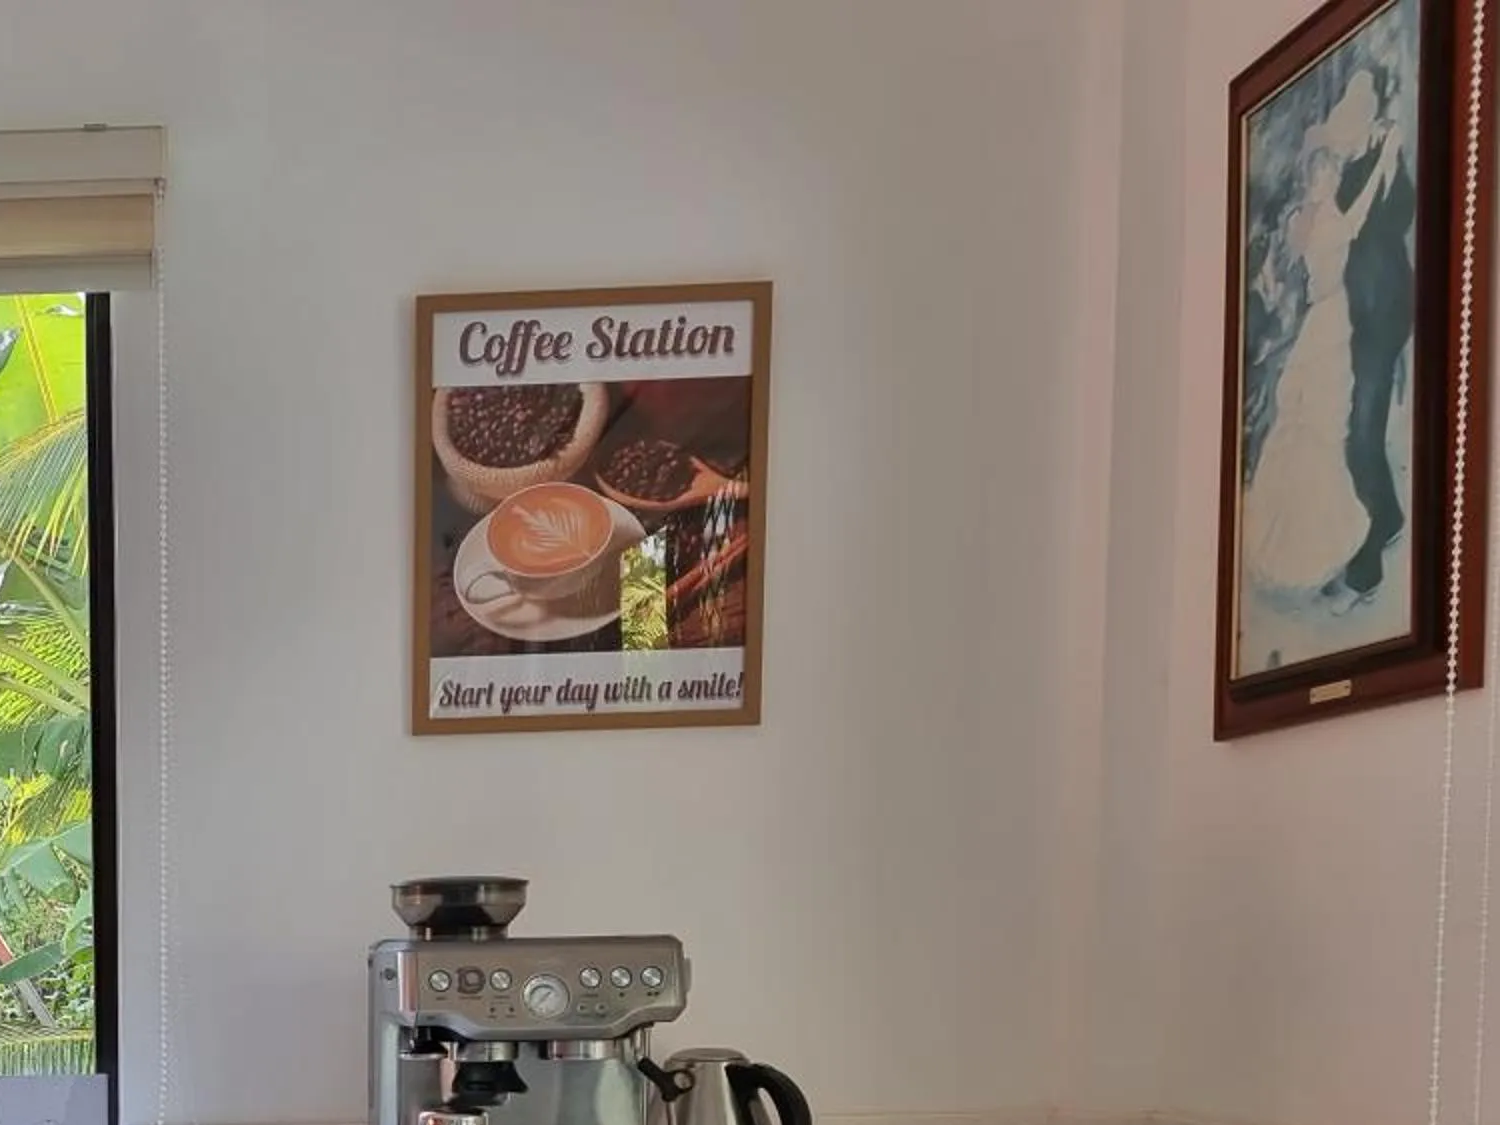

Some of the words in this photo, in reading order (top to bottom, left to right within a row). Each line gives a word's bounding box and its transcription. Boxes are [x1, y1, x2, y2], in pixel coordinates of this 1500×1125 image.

[459, 319, 573, 377] Coffee
[585, 315, 735, 359] Station
[438, 679, 494, 708] Start
[499, 683, 551, 714] your
[556, 678, 599, 712] day
[603, 675, 652, 702] with
[657, 680, 673, 701] a
[677, 671, 746, 701] smile!
